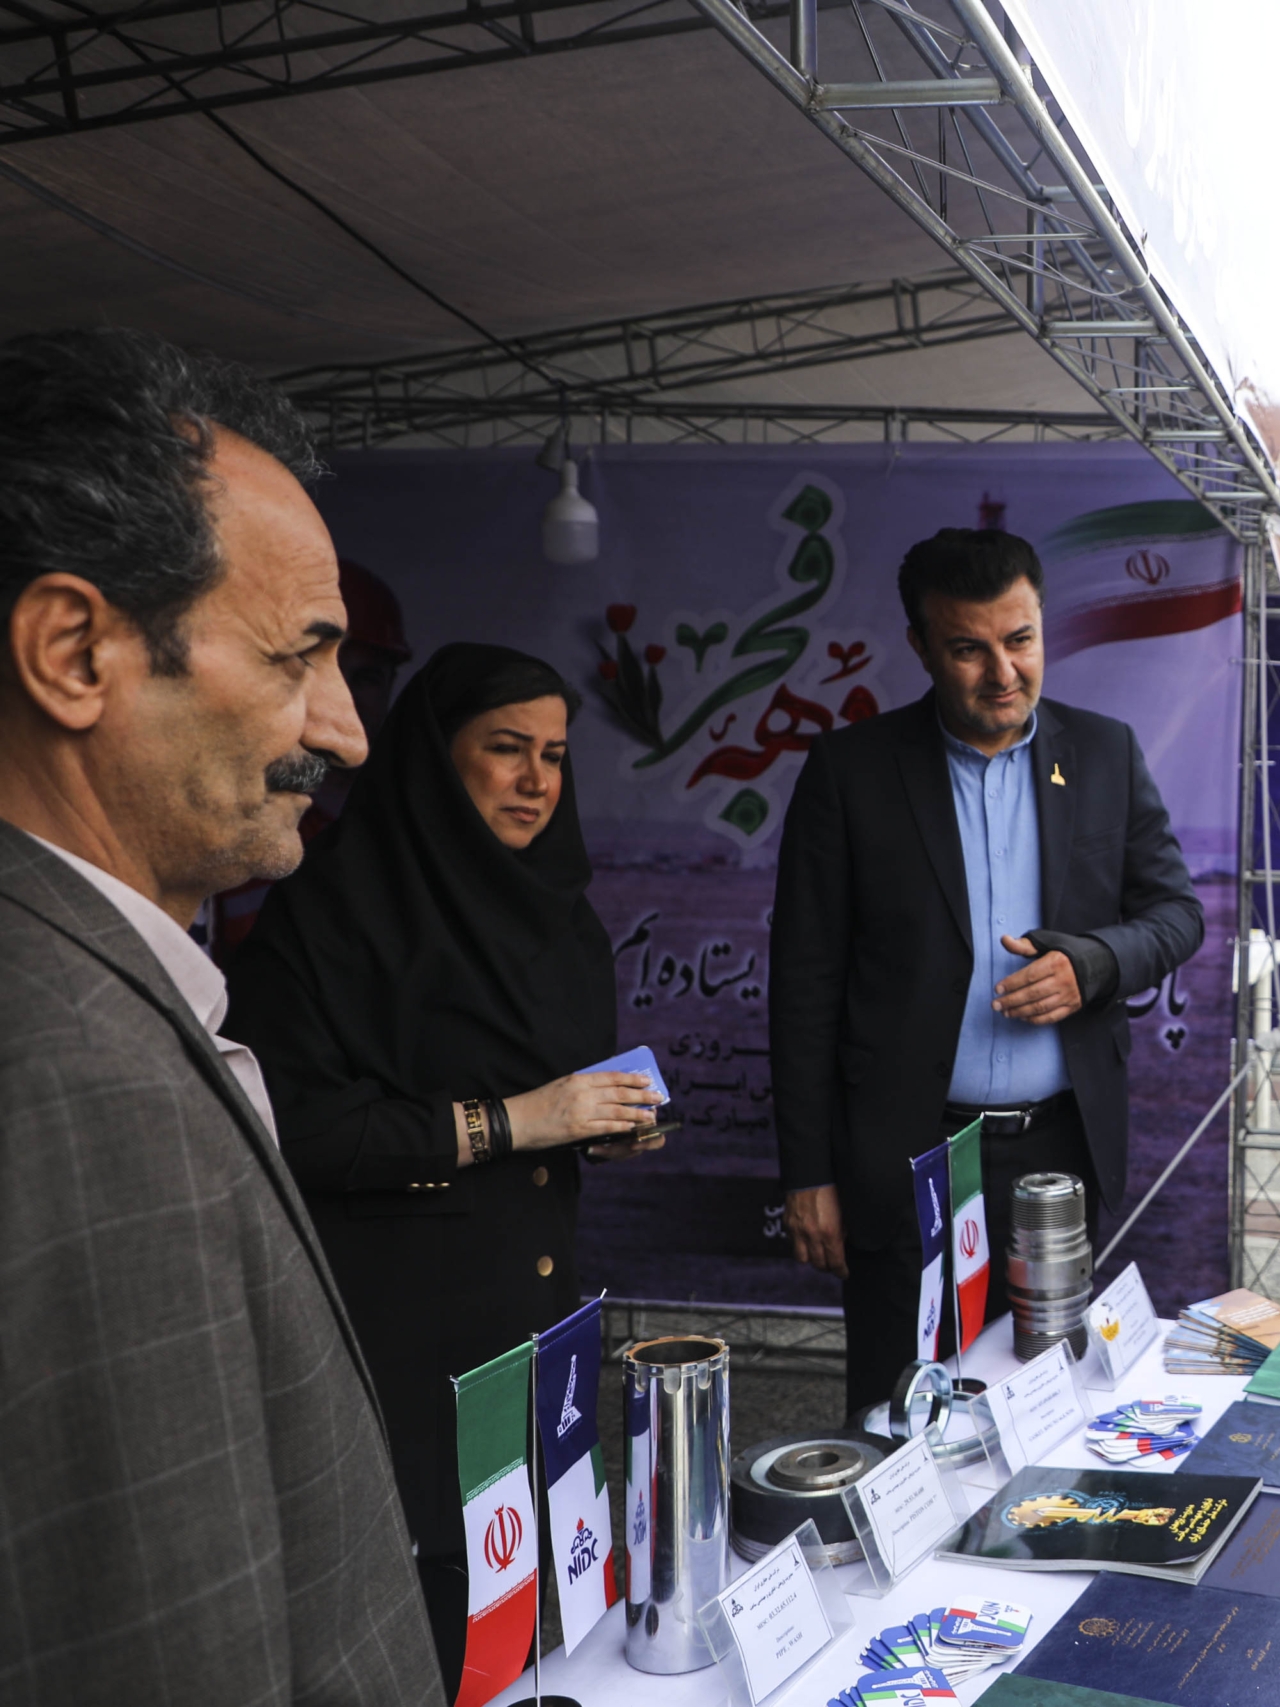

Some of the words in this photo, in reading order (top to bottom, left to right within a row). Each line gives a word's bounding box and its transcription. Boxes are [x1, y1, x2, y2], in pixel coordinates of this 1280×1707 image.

[657, 942, 762, 1000] یستاده
[669, 1032, 771, 1061] روزی
[567, 1537, 599, 1586] NIDC
[979, 1600, 1001, 1621] NIDC
[788, 1632, 803, 1647] WASH
